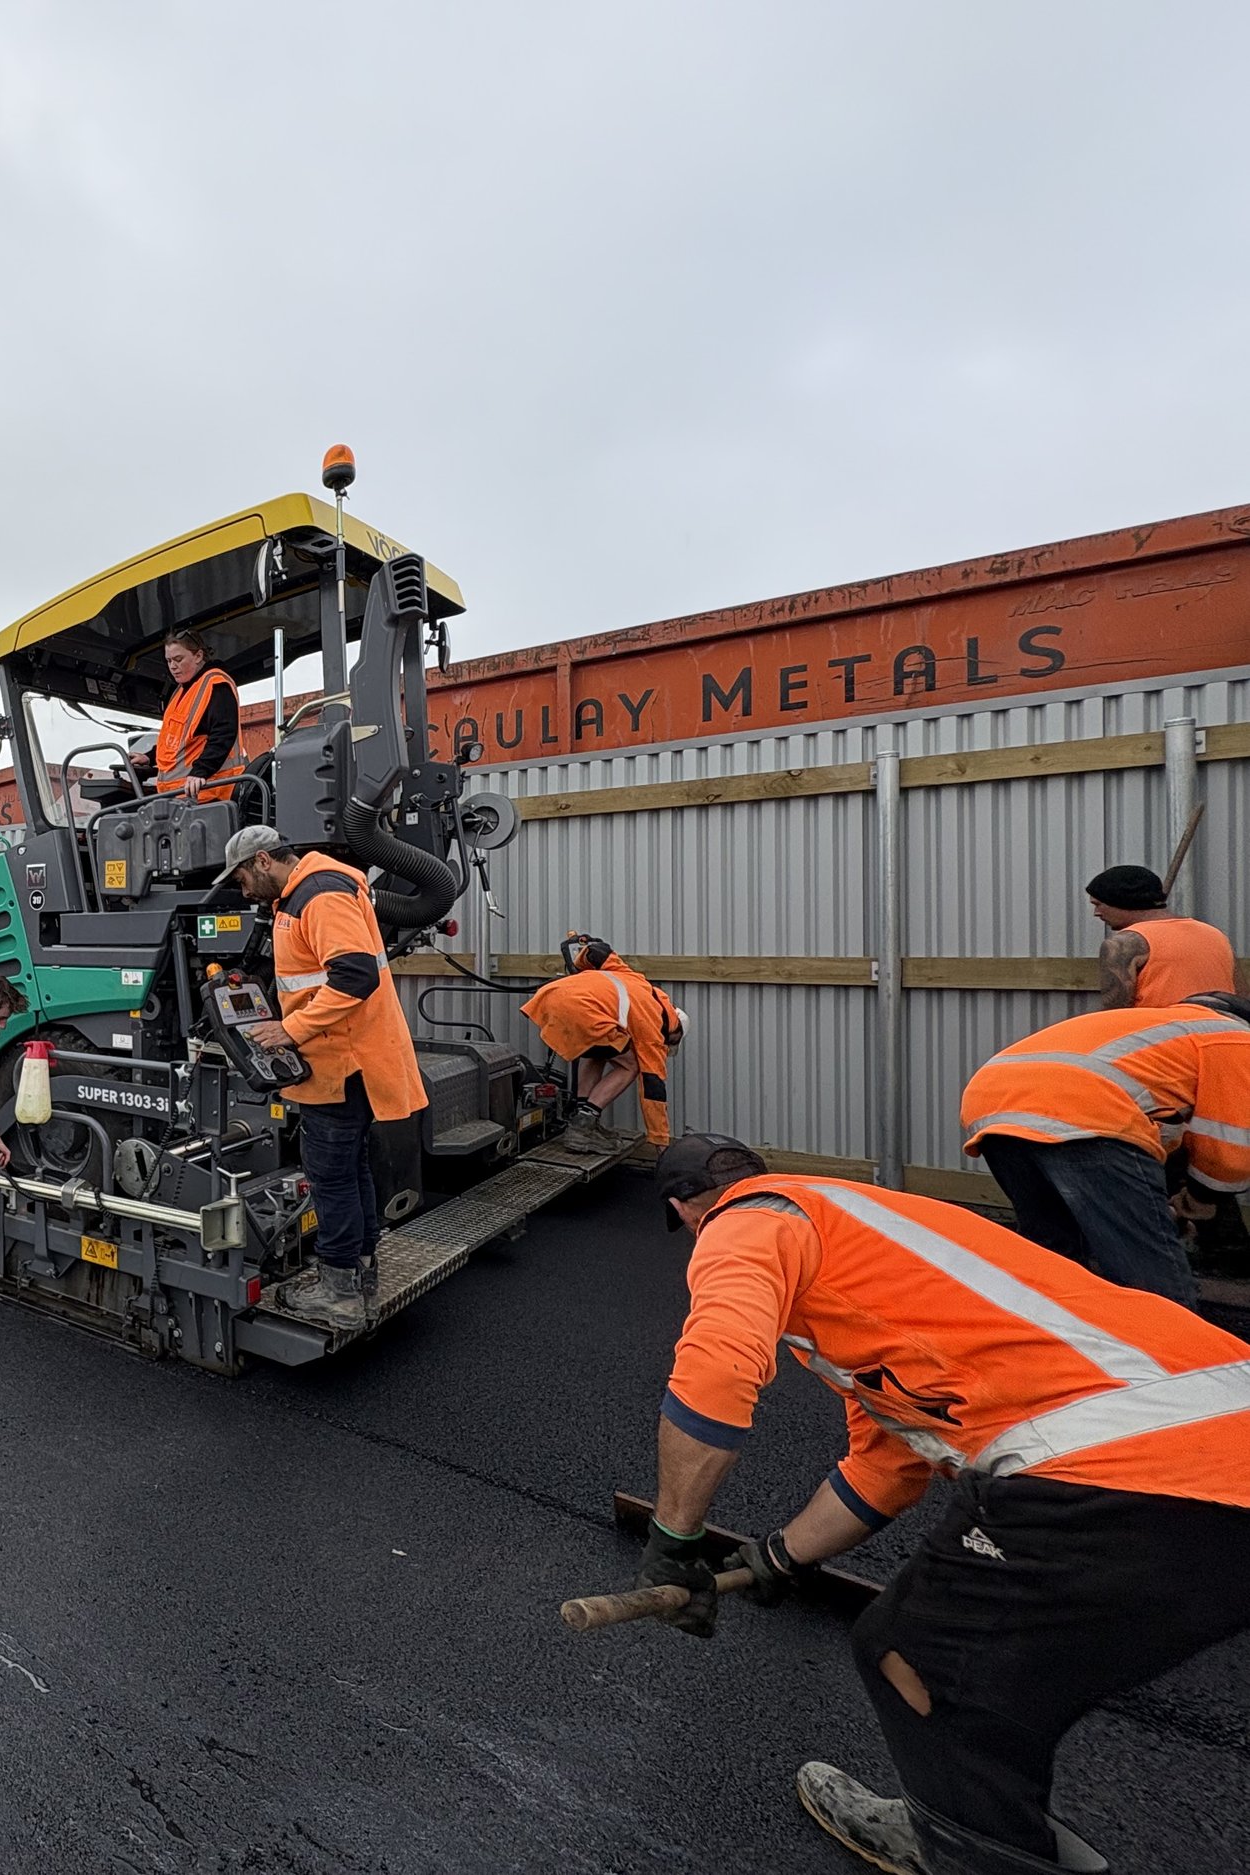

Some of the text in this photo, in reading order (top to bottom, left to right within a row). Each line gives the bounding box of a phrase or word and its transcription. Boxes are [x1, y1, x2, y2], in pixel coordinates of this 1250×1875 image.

[701, 625, 1066, 722] METALS
[77, 1085, 169, 1112] SUPER 1303-3i
[962, 1535, 1007, 1562] PEAK
